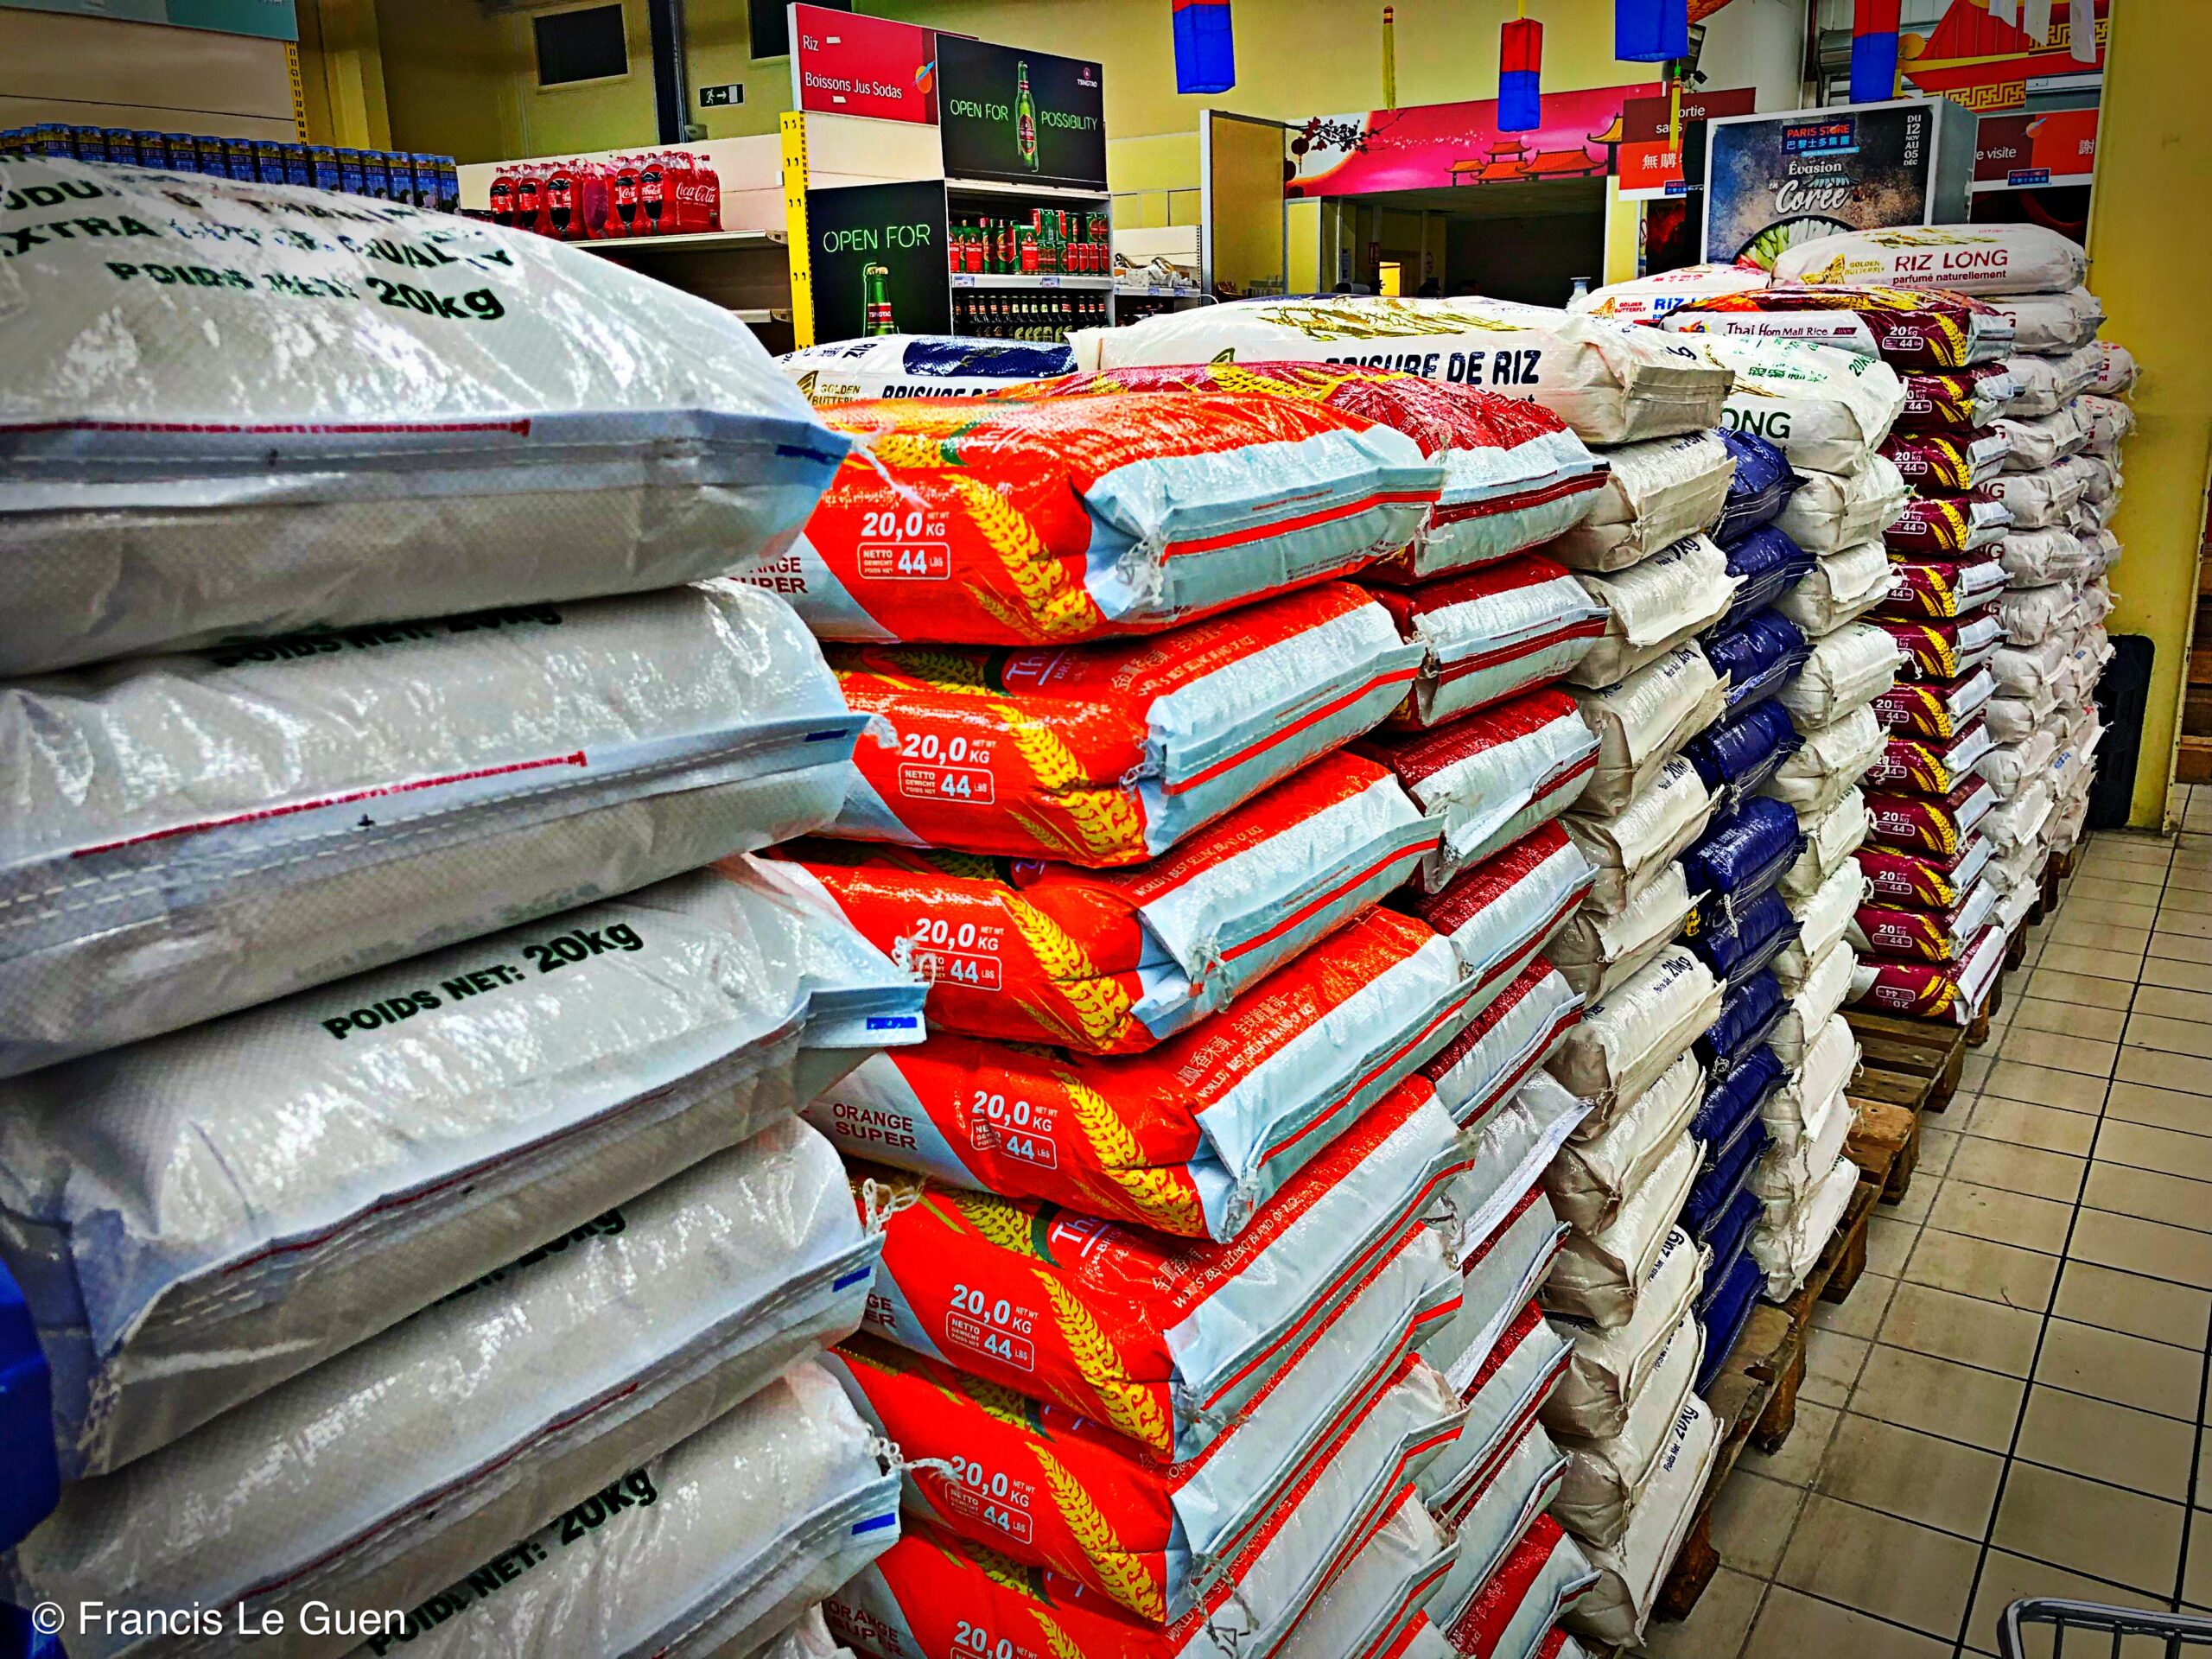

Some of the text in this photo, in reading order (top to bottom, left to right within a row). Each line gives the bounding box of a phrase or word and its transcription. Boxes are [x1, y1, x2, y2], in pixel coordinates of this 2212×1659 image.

[803, 35, 819, 52] Riz
[804, 71, 903, 99] Boissons Jus Sodas
[950, 99, 1098, 130] OPEN FOR POSSIBILITY
[1678, 105, 1707, 119] ortie
[1906, 114, 1922, 124] DU
[1655, 123, 1684, 135] sas
[1786, 124, 1851, 138] PARIS STORE
[1905, 124, 1921, 136] 12
[1904, 141, 1920, 150] AU
[1986, 146, 2017, 161] visite
[1903, 158, 1918, 167] DÉC
[1904, 150, 1919, 160] 05
[1788, 160, 1842, 176] Évasion
[1774, 178, 1851, 214] Corée
[823, 223, 931, 253] OPEN FOR
[1848, 260, 1881, 269] GOLDEN
[1894, 249, 2009, 272] RIZ LONG
[1892, 269, 2007, 285] parfumé naturellement
[105, 261, 255, 290] POIDS
[365, 276, 505, 321] 20kg
[1726, 322, 1828, 336] Thai Hom Rice
[1889, 326, 1918, 338] 20 kg
[1899, 338, 1913, 347] 44
[1446, 349, 1542, 385] DE RIZ
[1915, 391, 1926, 401] kg
[1908, 402, 1923, 411] 44
[1721, 407, 1791, 439] ONG
[1894, 451, 1922, 463] 20 kg
[1903, 463, 1917, 473] 44
[1910, 512, 1922, 522] kg
[861, 511, 945, 543] 20,0 KG
[1903, 522, 1916, 531] 44
[863, 549, 893, 559] NETTO
[898, 549, 944, 575] 44 LBS
[1890, 588, 1904, 599] 44
[1875, 698, 1904, 711] 20 kg
[1885, 710, 1899, 721] 44
[901, 732, 991, 766] 20,0 KG
[904, 769, 936, 781] NETTO
[940, 772, 988, 798] 44 LBS
[1882, 810, 1899, 822] 20
[1891, 823, 1906, 834] 44
[1167, 861, 1191, 880] BEST
[1186, 846, 1217, 868] SELLING
[1878, 870, 1897, 881] 20
[1889, 882, 1904, 893] 44
[913, 917, 1000, 951] 20,0 KG
[1878, 923, 1897, 935] 20
[1889, 937, 1904, 946] 44
[950, 958, 979, 983] 44
[981, 969, 995, 980] LBS
[1661, 956, 1694, 978] 20kg
[321, 921, 645, 1040] POIDS NET: 20kg
[1226, 1052, 1248, 1073] BEST
[1243, 1032, 1274, 1059] SELLING
[832, 1102, 915, 1134] ORANGE
[971, 1090, 1053, 1133] 20,0 KG
[835, 1121, 918, 1151] SUPER
[1006, 1135, 1051, 1160] 44 LBS
[1247, 1217, 1275, 1244] BRAND
[950, 1282, 1033, 1335] 20,0 KG
[951, 1318, 981, 1336] NETTO
[983, 1332, 1028, 1361] 44 LBS
[1662, 1453, 1676, 1472] Poids
[950, 1454, 1030, 1508] 20,0 KG
[983, 1504, 1027, 1534] 44 LBS
[467, 1541, 549, 1599] NET:
[557, 1467, 658, 1548] 20kg
[830, 1599, 900, 1643] ORANGE
[831, 1616, 904, 1657] SUPER
[953, 1619, 1014, 1659] 20,0
